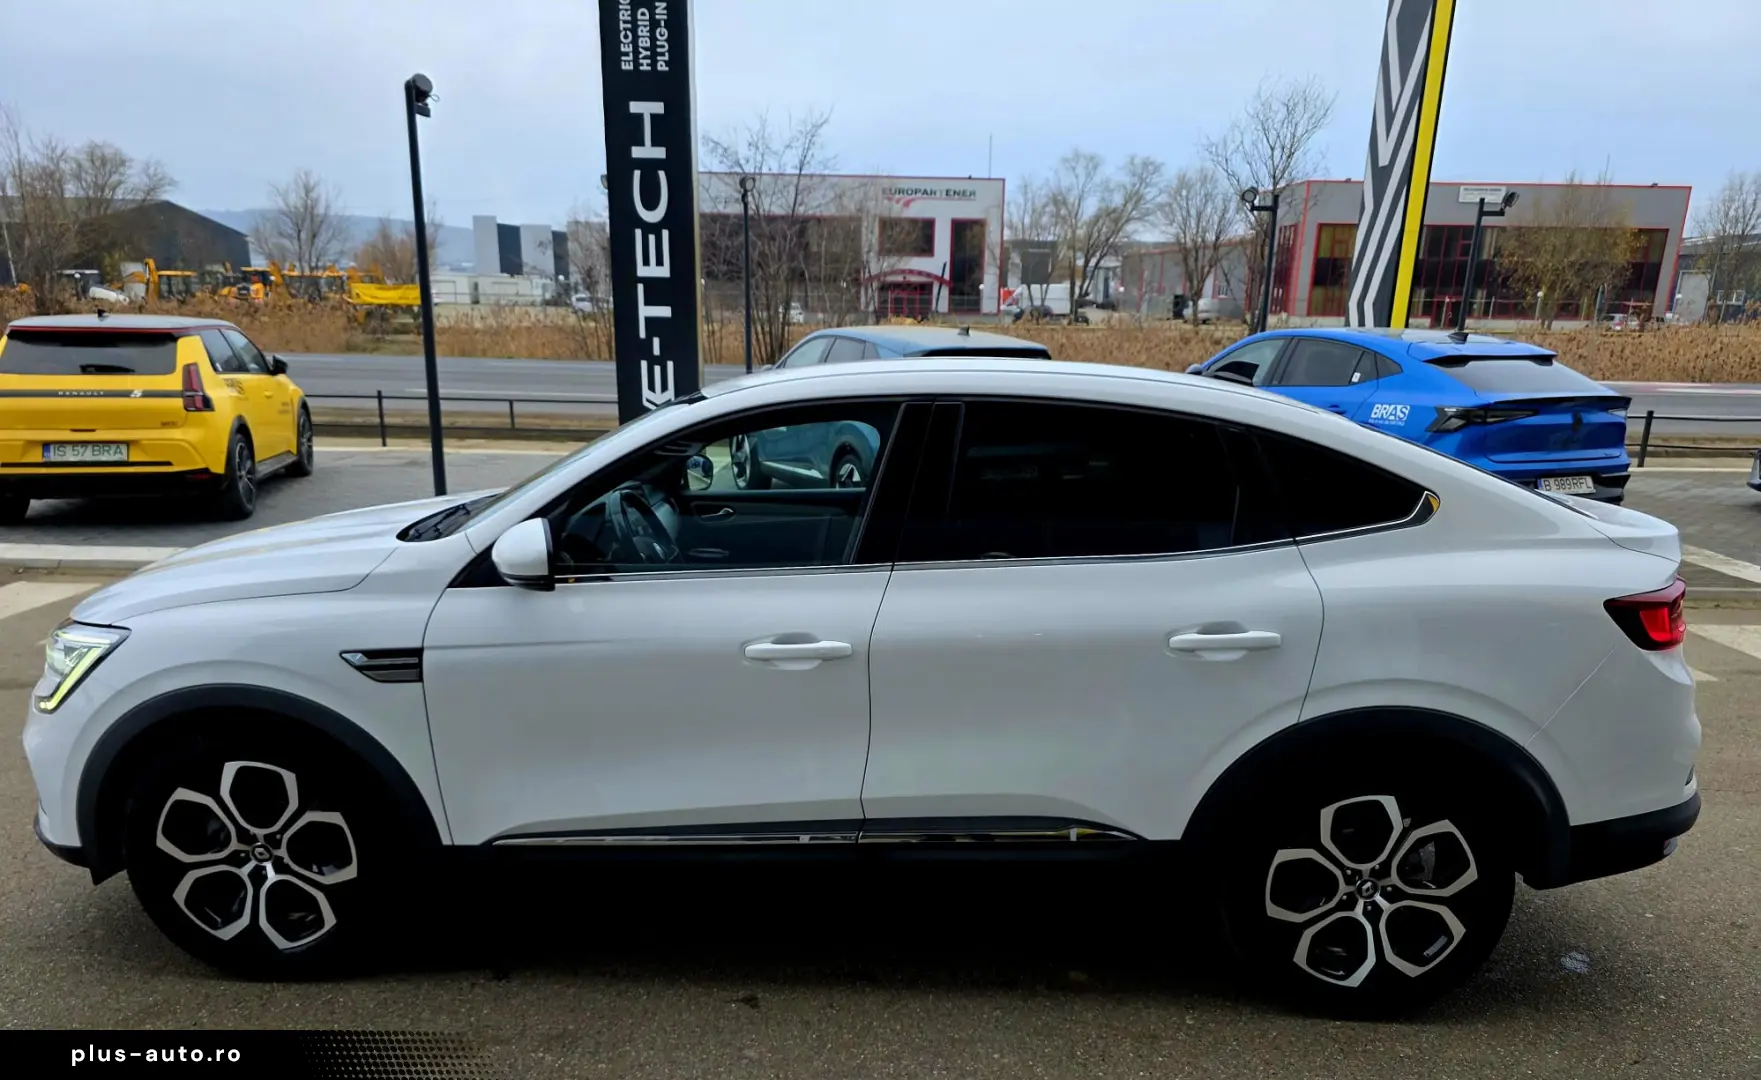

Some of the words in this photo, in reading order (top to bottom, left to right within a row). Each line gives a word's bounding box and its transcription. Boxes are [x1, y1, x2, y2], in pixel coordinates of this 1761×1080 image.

[637, 8, 652, 70] HYBRID
[655, 2, 669, 71] PLUG-IN
[629, 101, 675, 410] E-TECH
[1370, 403, 1410, 421] BRAS
[53, 444, 67, 457] IS
[71, 444, 88, 457] 57
[91, 444, 123, 457] BRA
[1543, 479, 1552, 491] B
